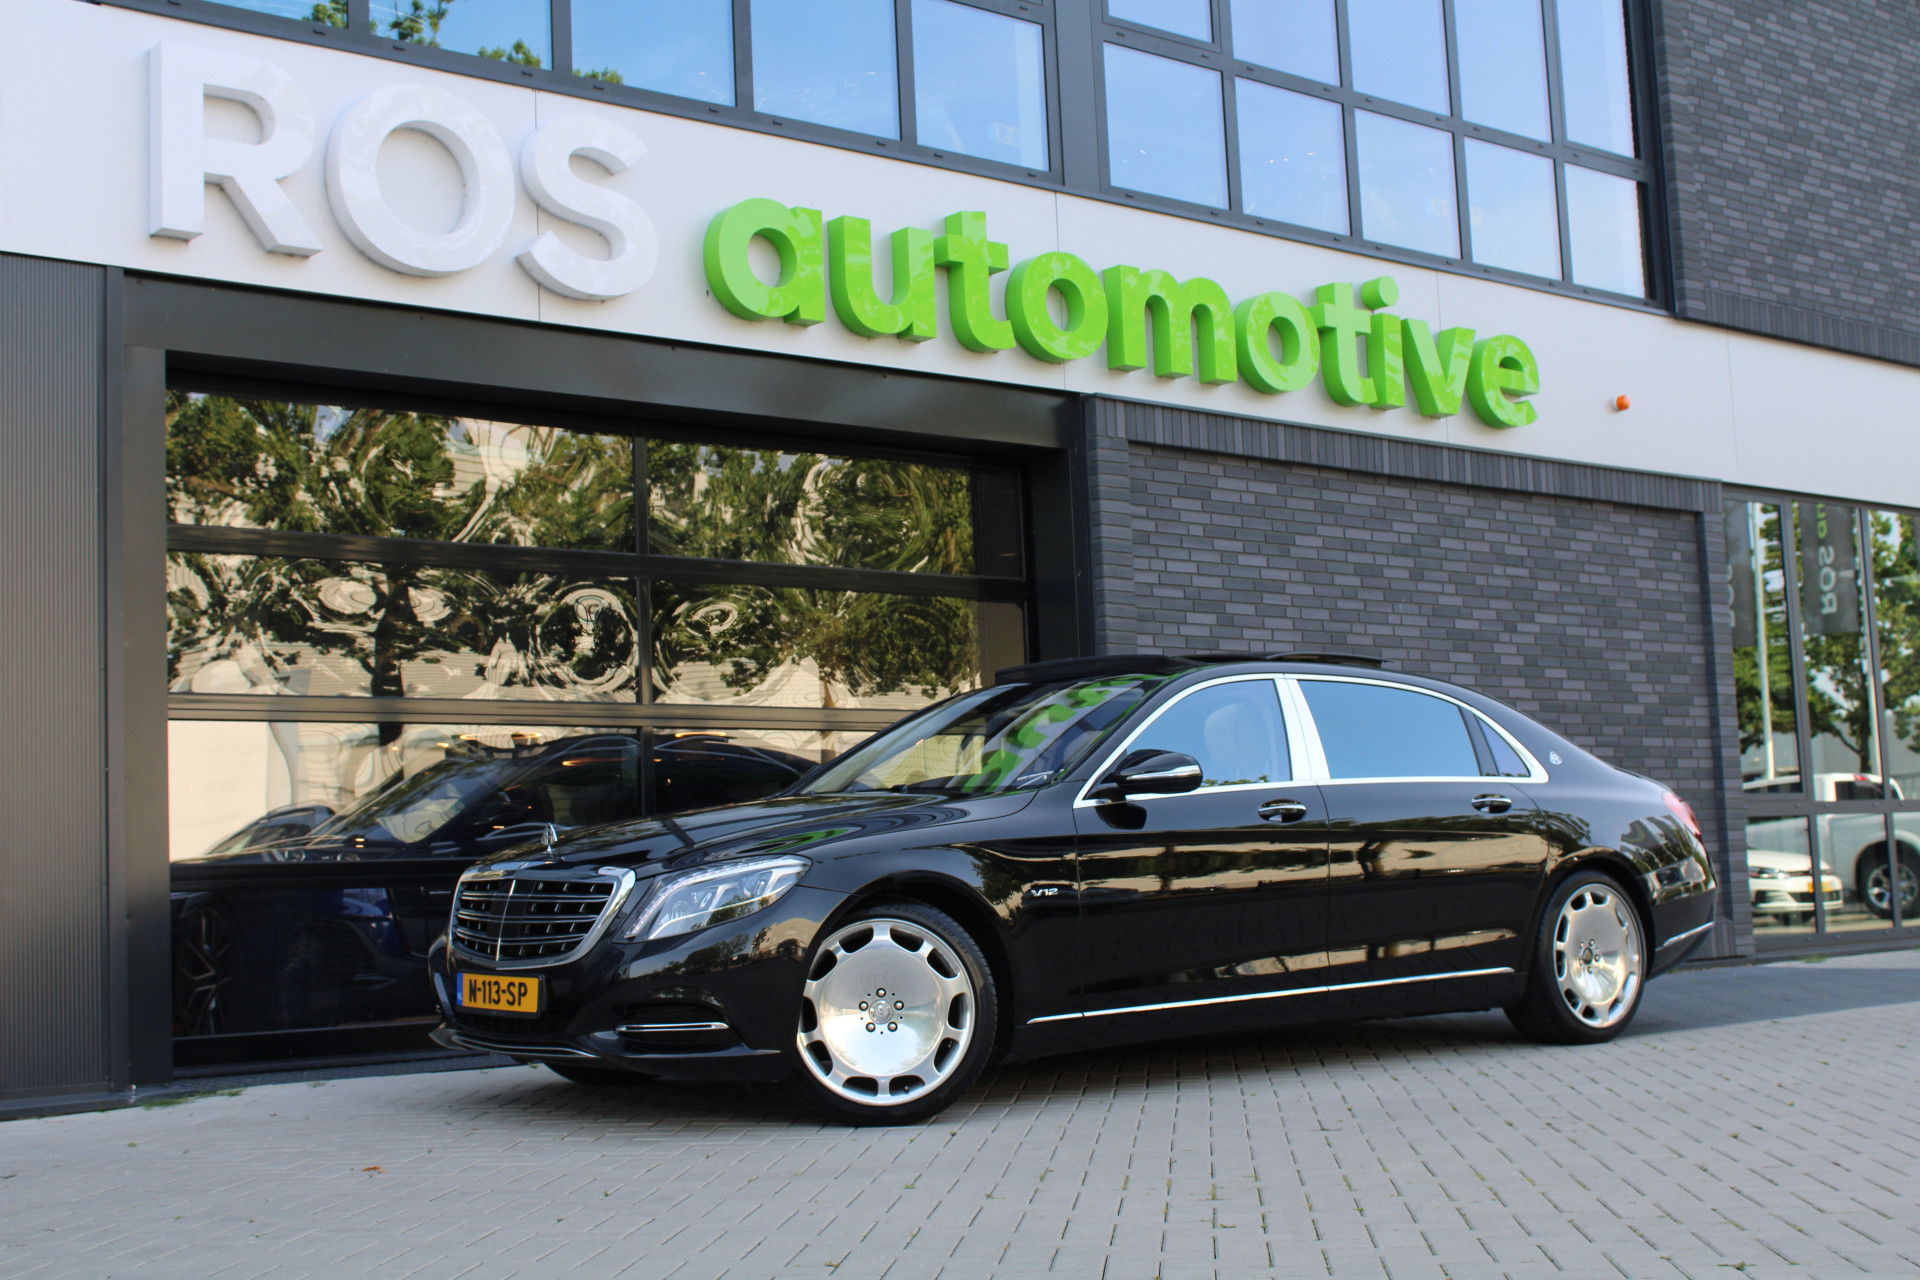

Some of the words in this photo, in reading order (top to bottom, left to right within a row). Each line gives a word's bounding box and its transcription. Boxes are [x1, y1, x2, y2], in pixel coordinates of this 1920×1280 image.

[149, 41, 659, 300] ROS
[703, 198, 1540, 429] automotive
[1031, 888, 1058, 897] V12
[468, 978, 528, 1006] N-113-SP
